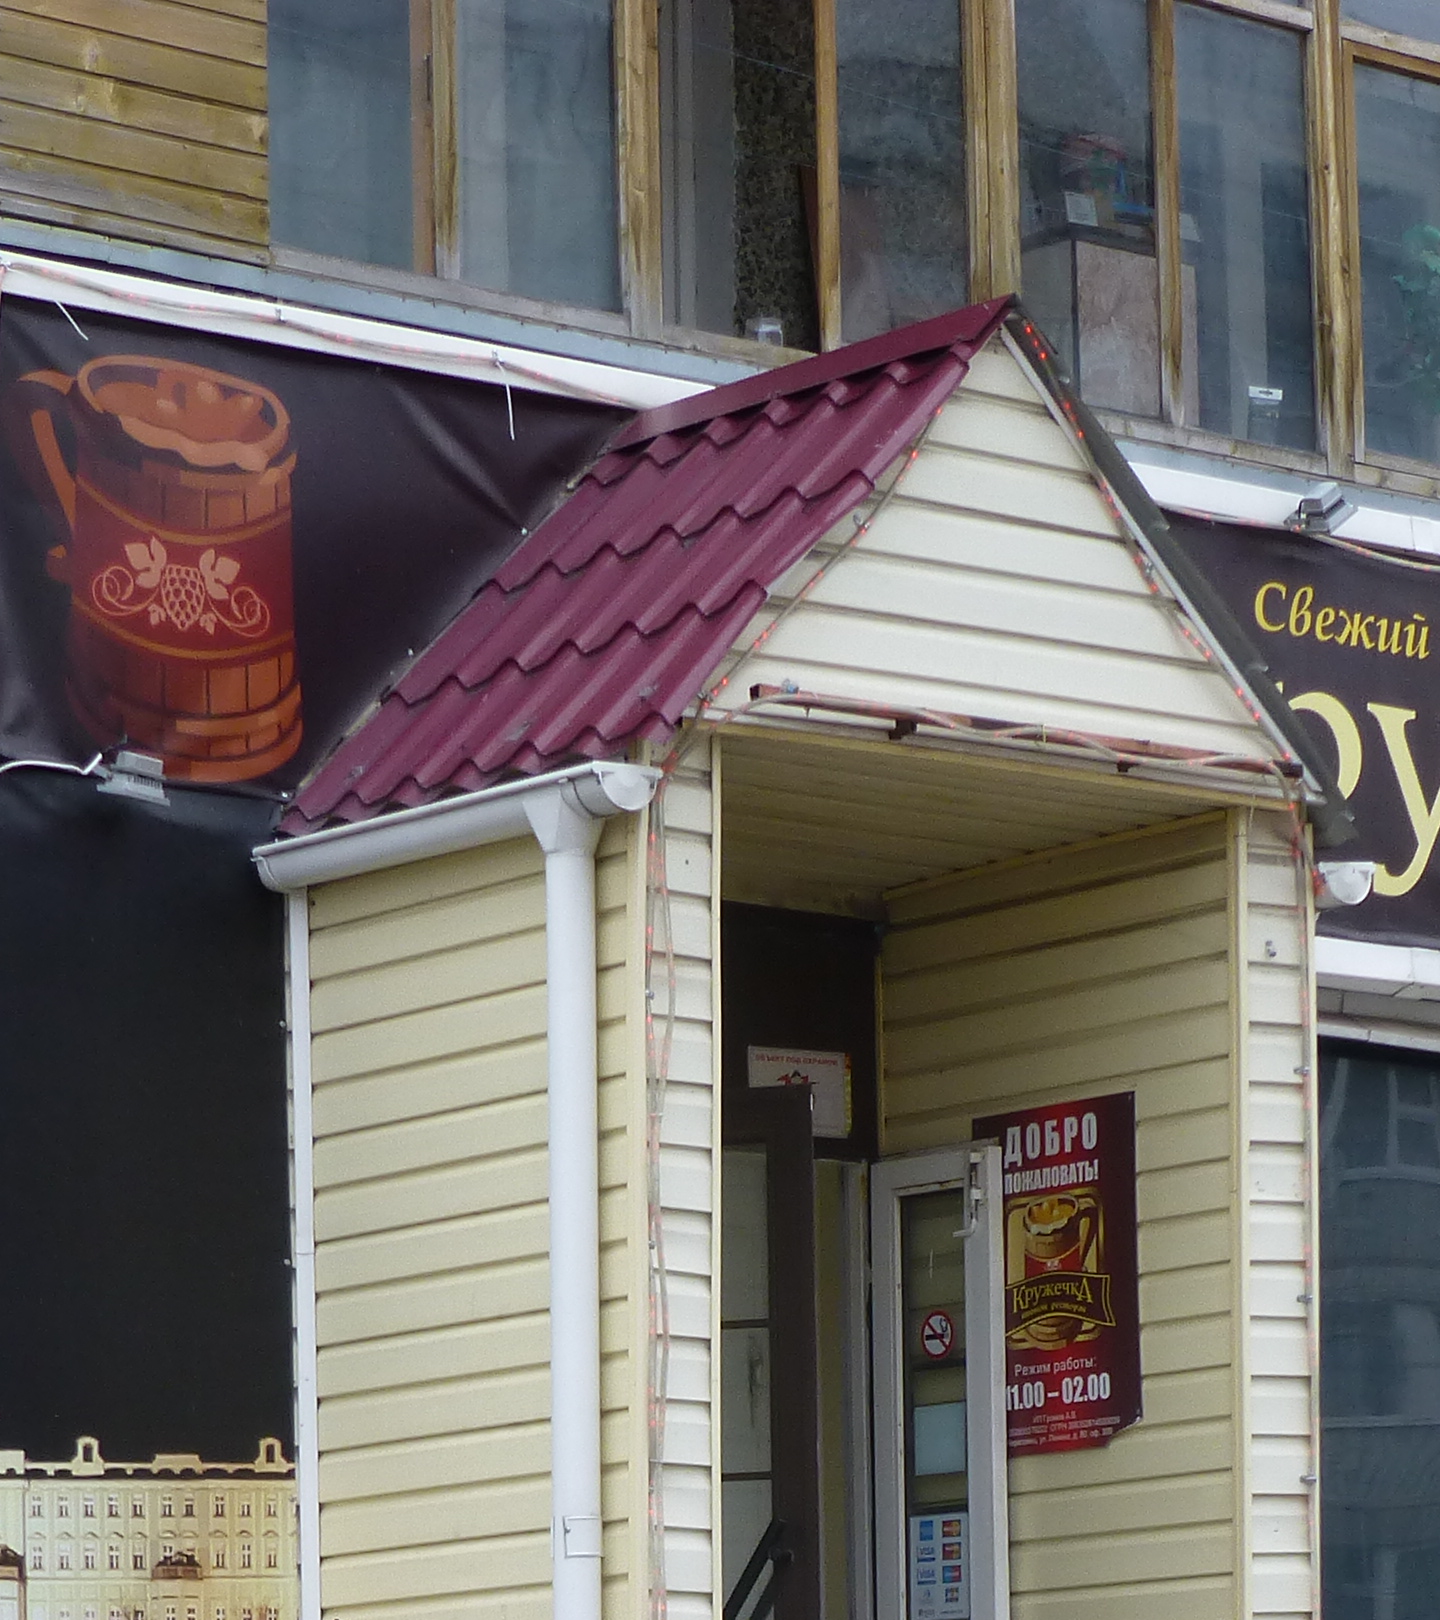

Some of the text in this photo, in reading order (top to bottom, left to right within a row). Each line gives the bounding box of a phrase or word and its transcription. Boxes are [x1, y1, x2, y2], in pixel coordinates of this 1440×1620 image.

[1254, 582, 1430, 660] Свежий
[1004, 1112, 1097, 1169] ДОБРО
[1004, 1159, 1099, 1194] ПОЖАЛОВАТЬ!
[1014, 1356, 1097, 1377] Режим работы:
[1006, 1381, 1045, 1411] 11.00
[1062, 1372, 1111, 1404] 02.00
